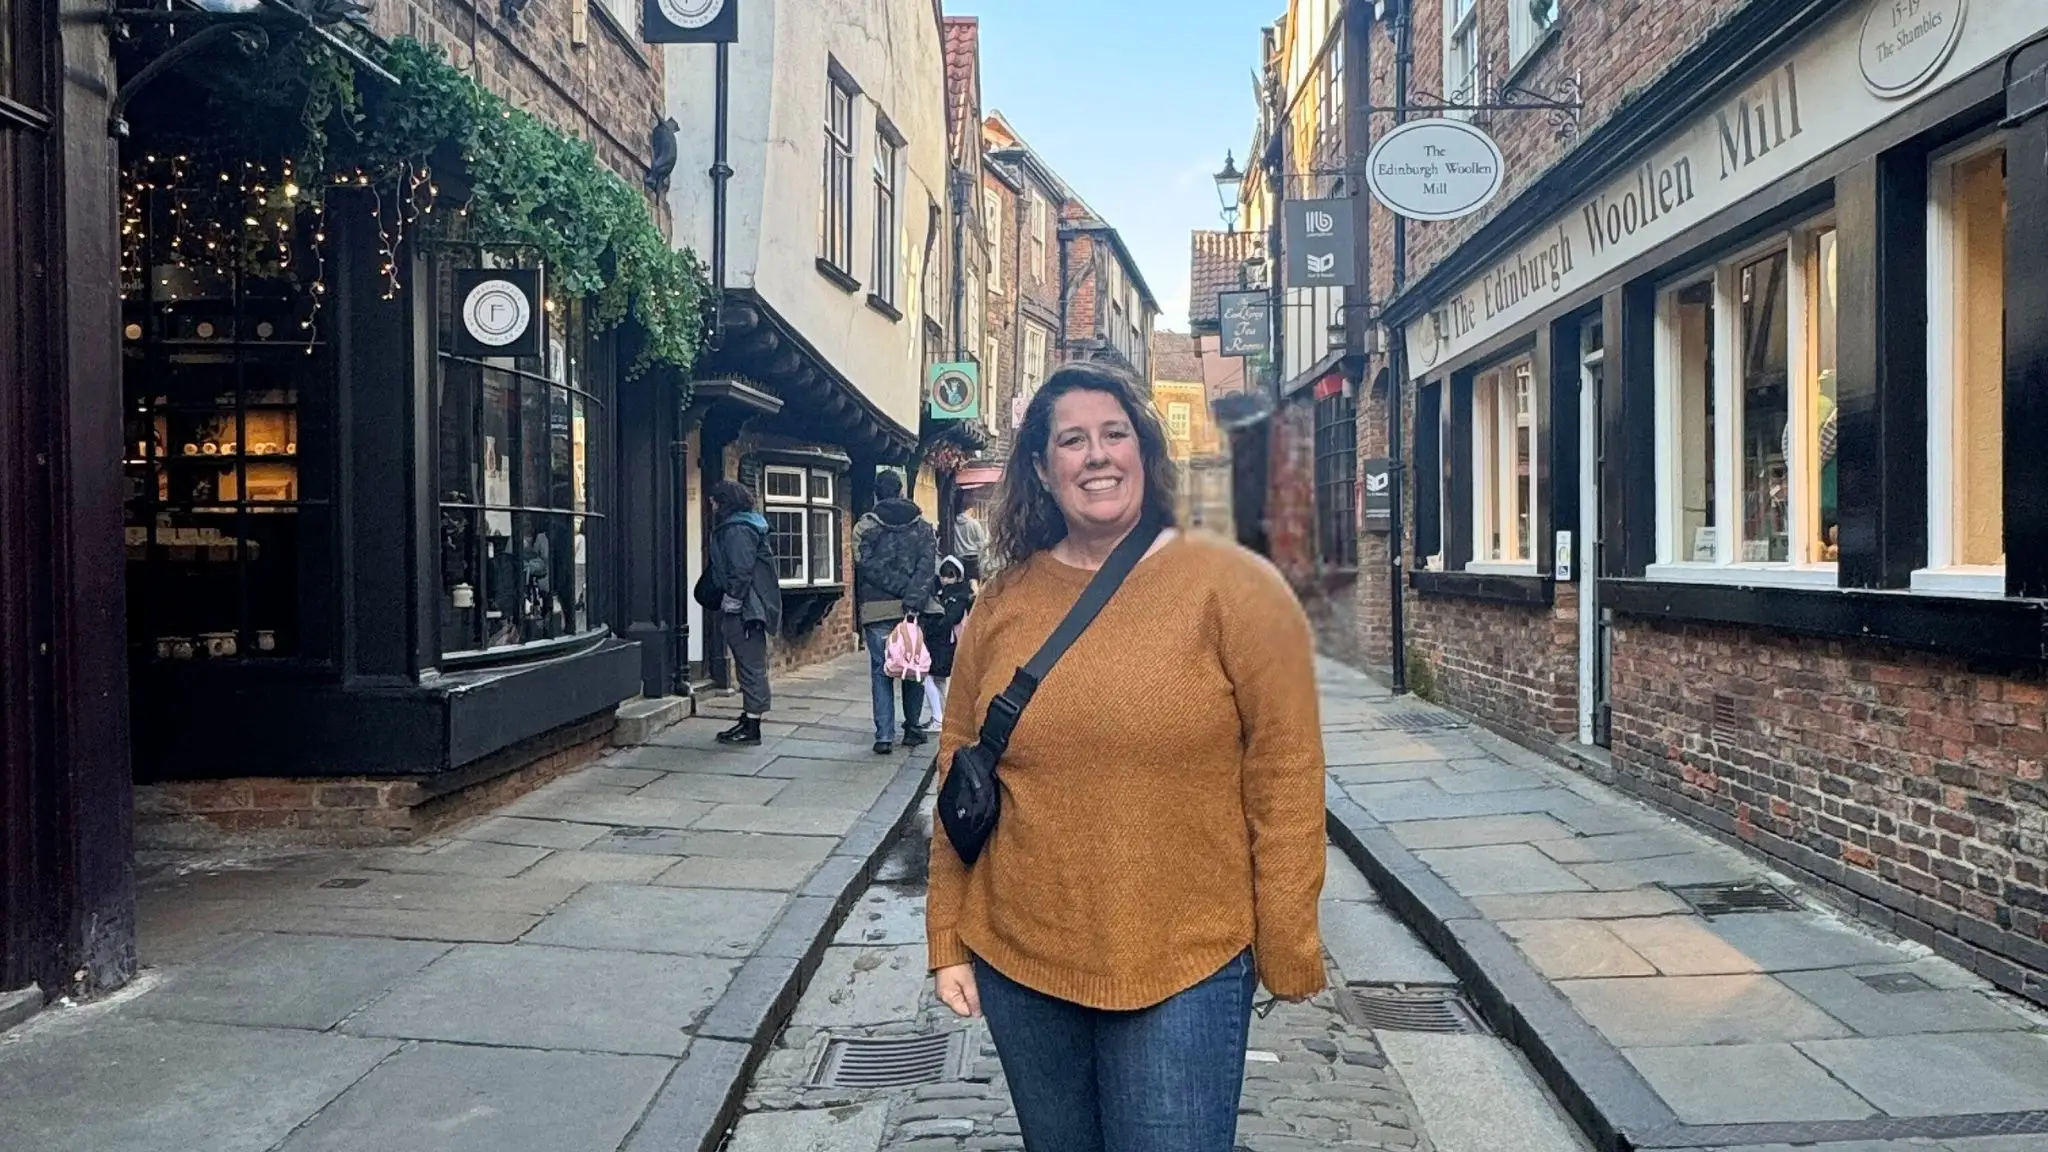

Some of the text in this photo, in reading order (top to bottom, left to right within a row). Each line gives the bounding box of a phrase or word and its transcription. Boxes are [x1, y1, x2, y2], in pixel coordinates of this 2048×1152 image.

[1876, 11, 1943, 62] The Shambles
[1423, 145, 1447, 157] The
[1378, 162, 1492, 178] Edinburgh Woollen
[1423, 182, 1448, 195] Mill
[1451, 61, 1803, 339] The Edinburgh Woollen Mill
